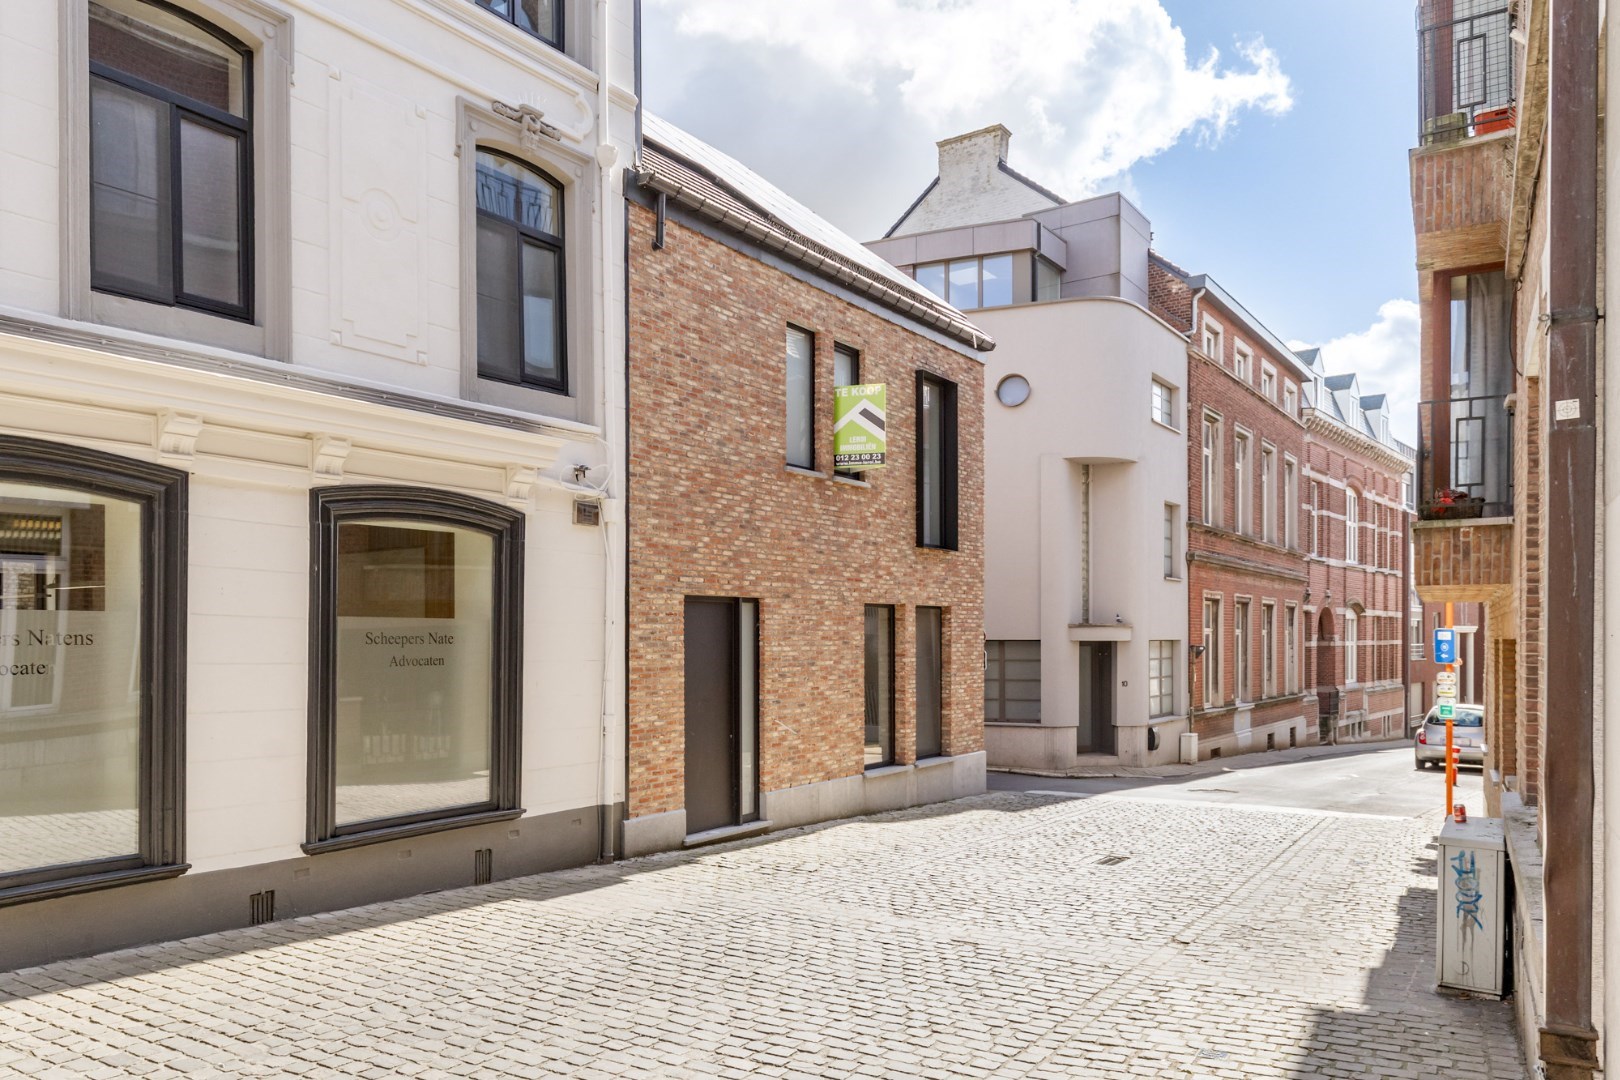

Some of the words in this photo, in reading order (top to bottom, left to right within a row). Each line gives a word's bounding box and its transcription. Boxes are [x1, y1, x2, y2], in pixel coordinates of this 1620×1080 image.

[835, 388, 848, 397] TE
[852, 385, 882, 396] KOOP
[27, 629, 94, 646] Natens
[365, 631, 425, 648] Scheepers
[428, 632, 454, 645] Nate
[389, 655, 445, 667] Advocaten
